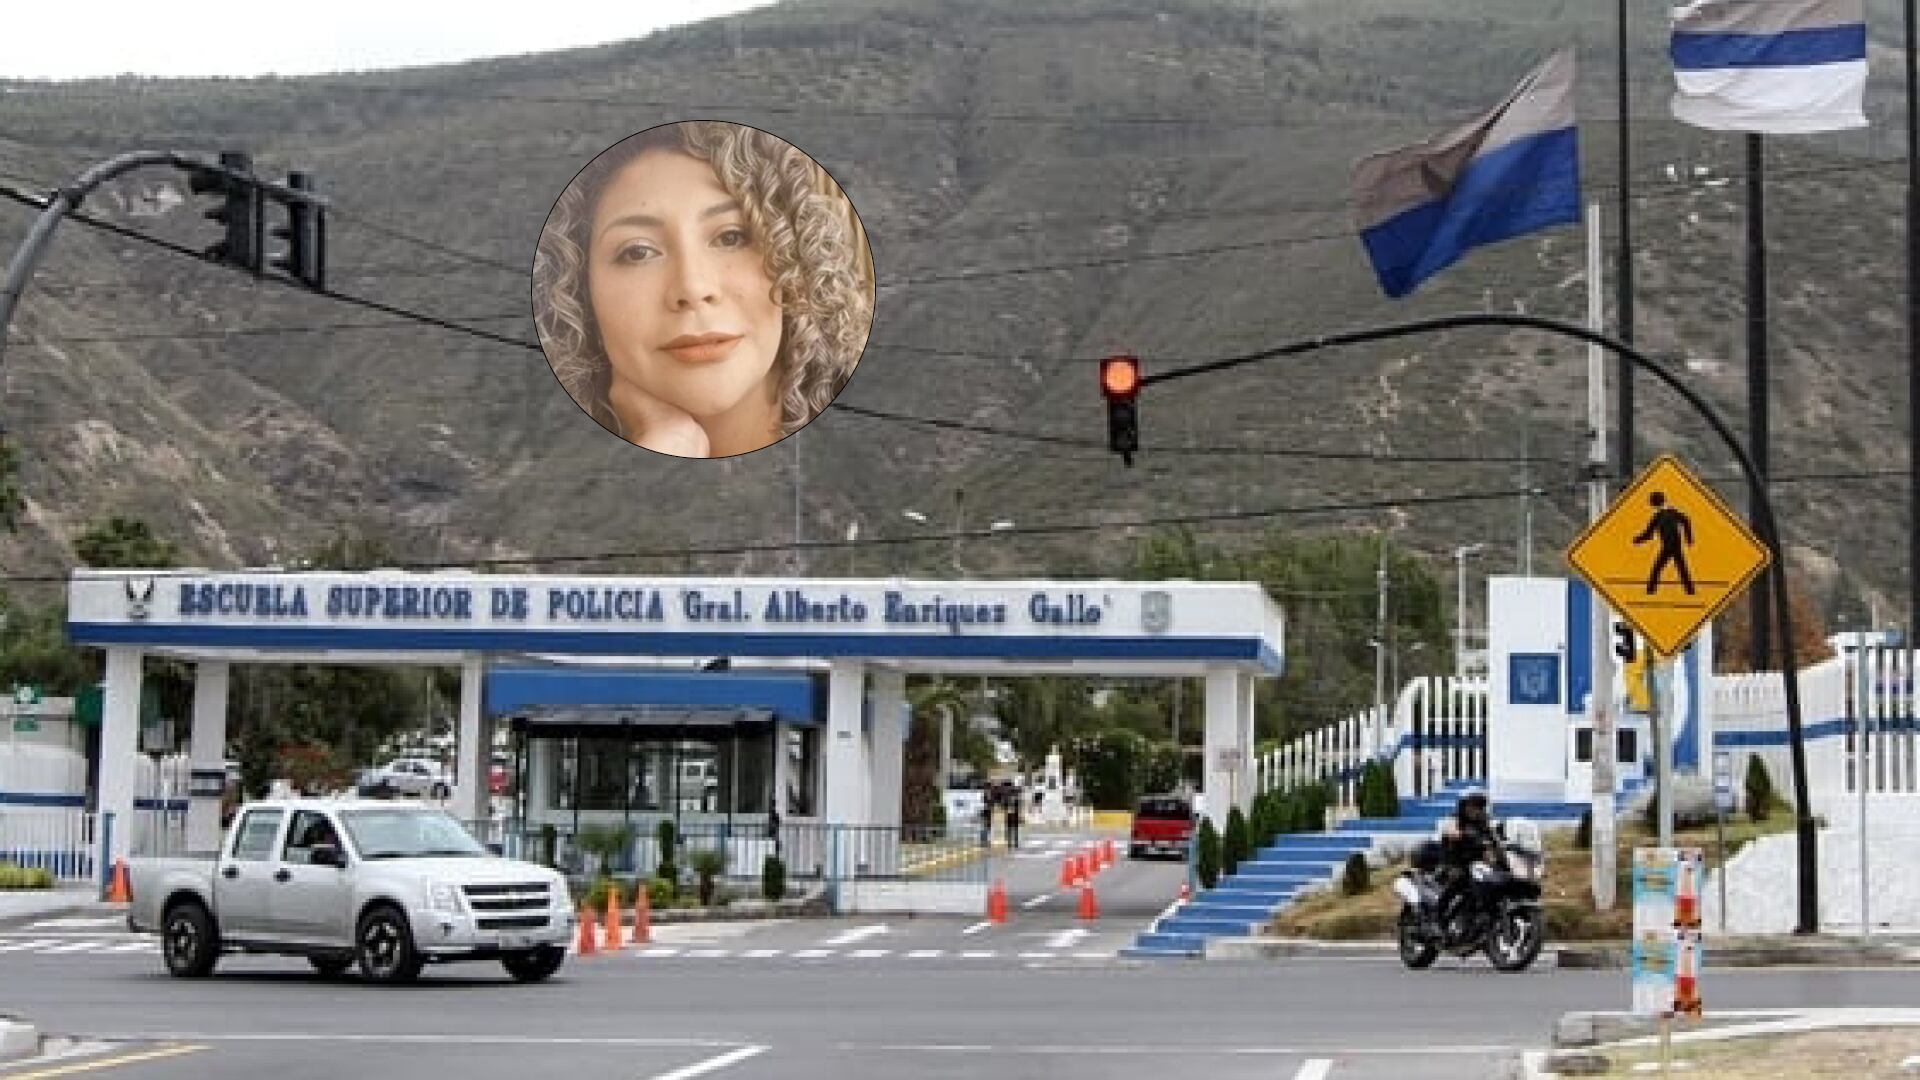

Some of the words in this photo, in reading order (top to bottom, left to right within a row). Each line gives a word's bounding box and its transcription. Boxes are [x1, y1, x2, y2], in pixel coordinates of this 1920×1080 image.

[180, 584, 307, 615] ESCUELA
[327, 587, 472, 618] SUPERIOR
[491, 588, 528, 619] DE
[548, 588, 664, 621] POLICIA
[764, 590, 867, 622] Alberto
